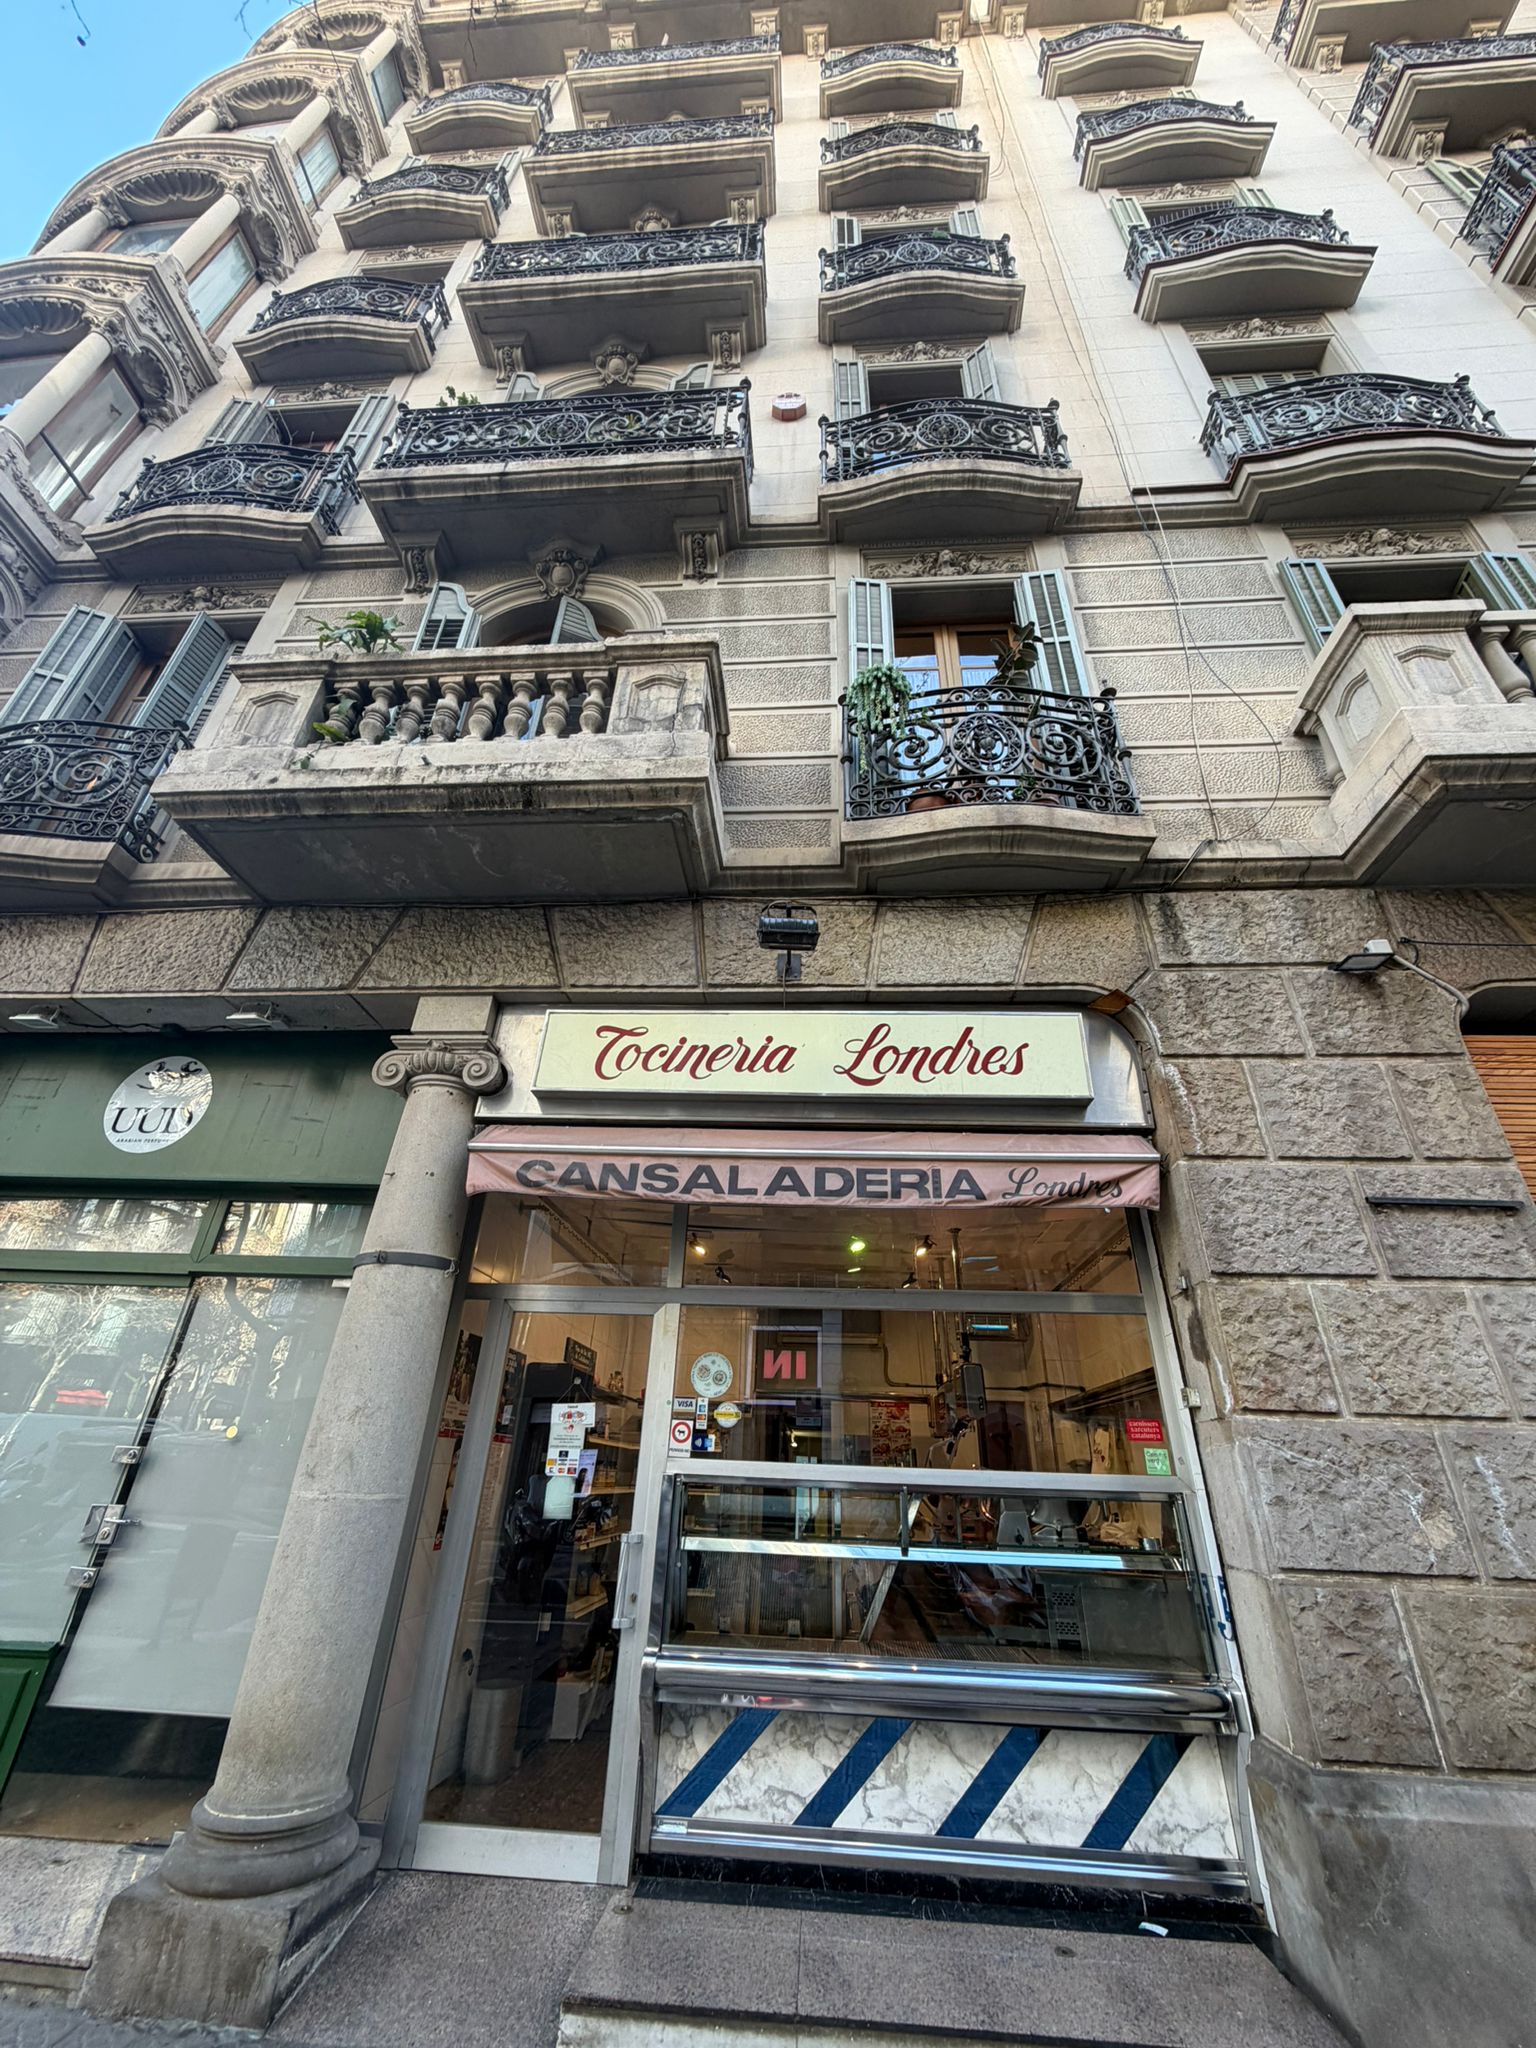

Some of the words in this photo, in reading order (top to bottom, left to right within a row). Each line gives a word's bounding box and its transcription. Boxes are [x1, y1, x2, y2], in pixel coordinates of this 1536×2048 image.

[595, 1025, 798, 1080] Tocineria
[833, 1023, 1029, 1086] Londres
[515, 1159, 987, 1200] CANSALADERIA
[1001, 1167, 1122, 1199] Londres
[677, 1400, 694, 1408] VISA
